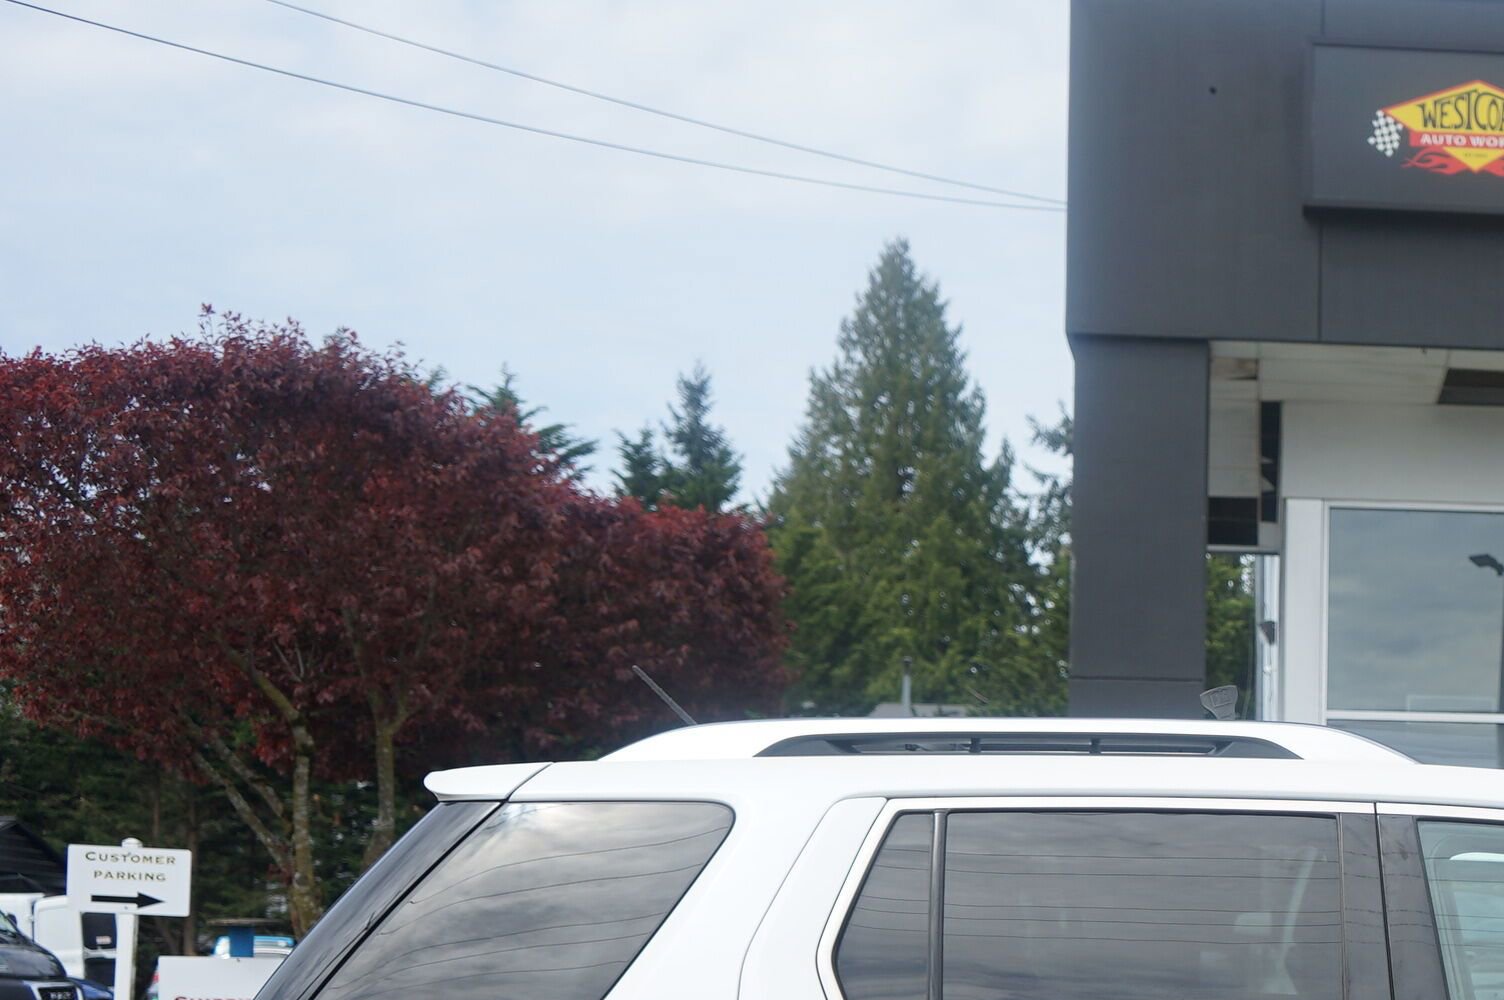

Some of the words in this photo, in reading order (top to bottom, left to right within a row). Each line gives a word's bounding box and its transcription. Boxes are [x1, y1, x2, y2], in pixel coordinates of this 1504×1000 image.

[1420, 132, 1467, 147] AUTO
[85, 851, 176, 864] CUSTOMER
[93, 870, 166, 882] PARKING
